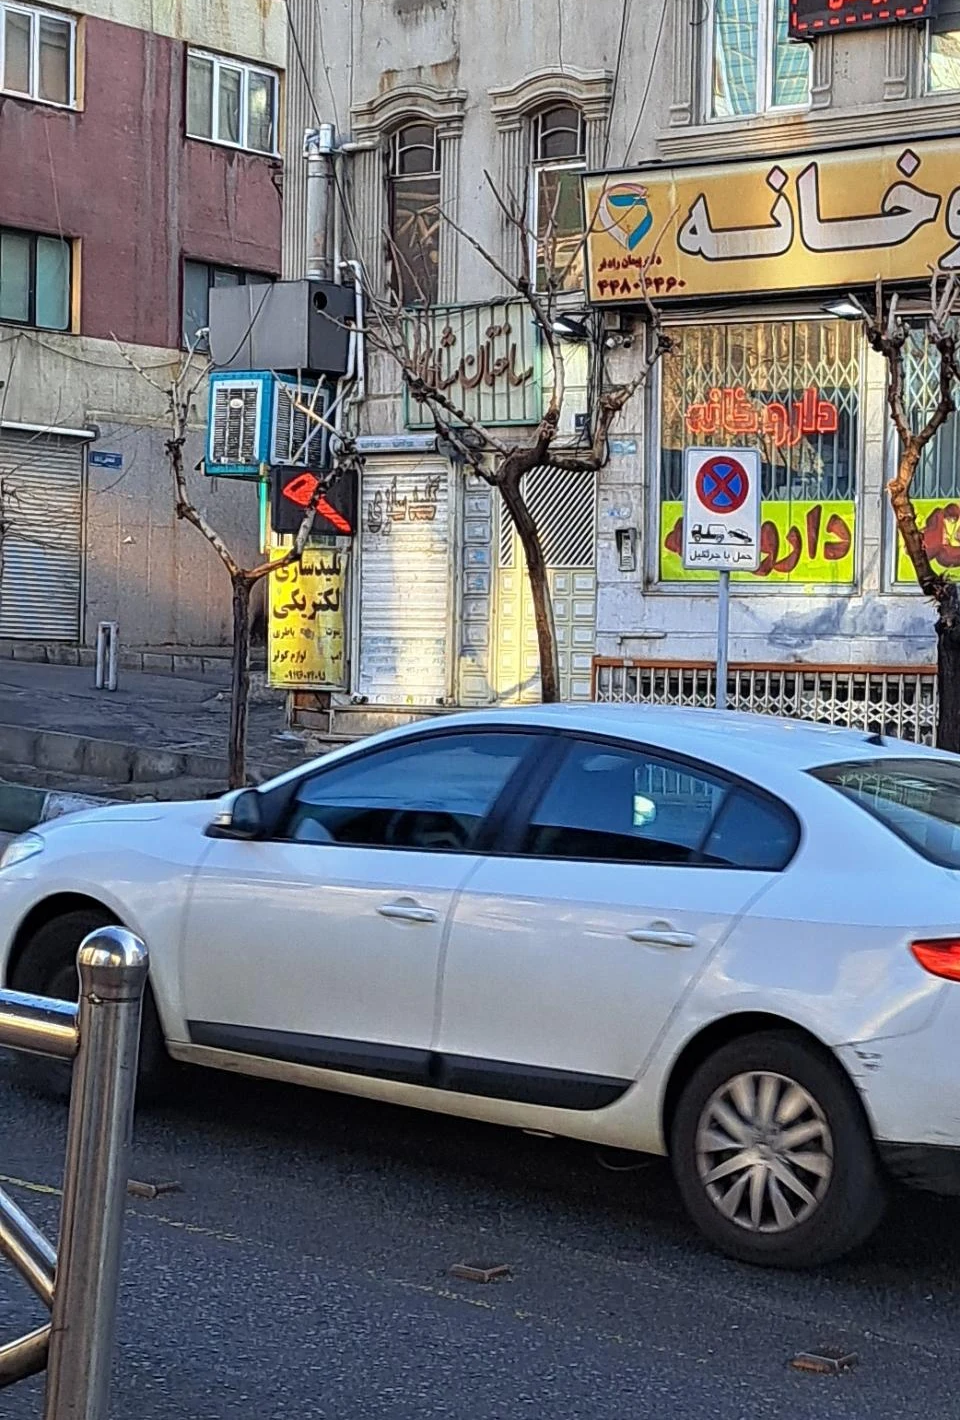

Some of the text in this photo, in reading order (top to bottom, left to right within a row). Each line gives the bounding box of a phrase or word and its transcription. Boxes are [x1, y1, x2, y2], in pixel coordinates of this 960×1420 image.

[684, 387, 838, 447] داروخانه
[689, 547, 753, 563] حمل با جرثقیل
[272, 587, 341, 621] لکتریکی
